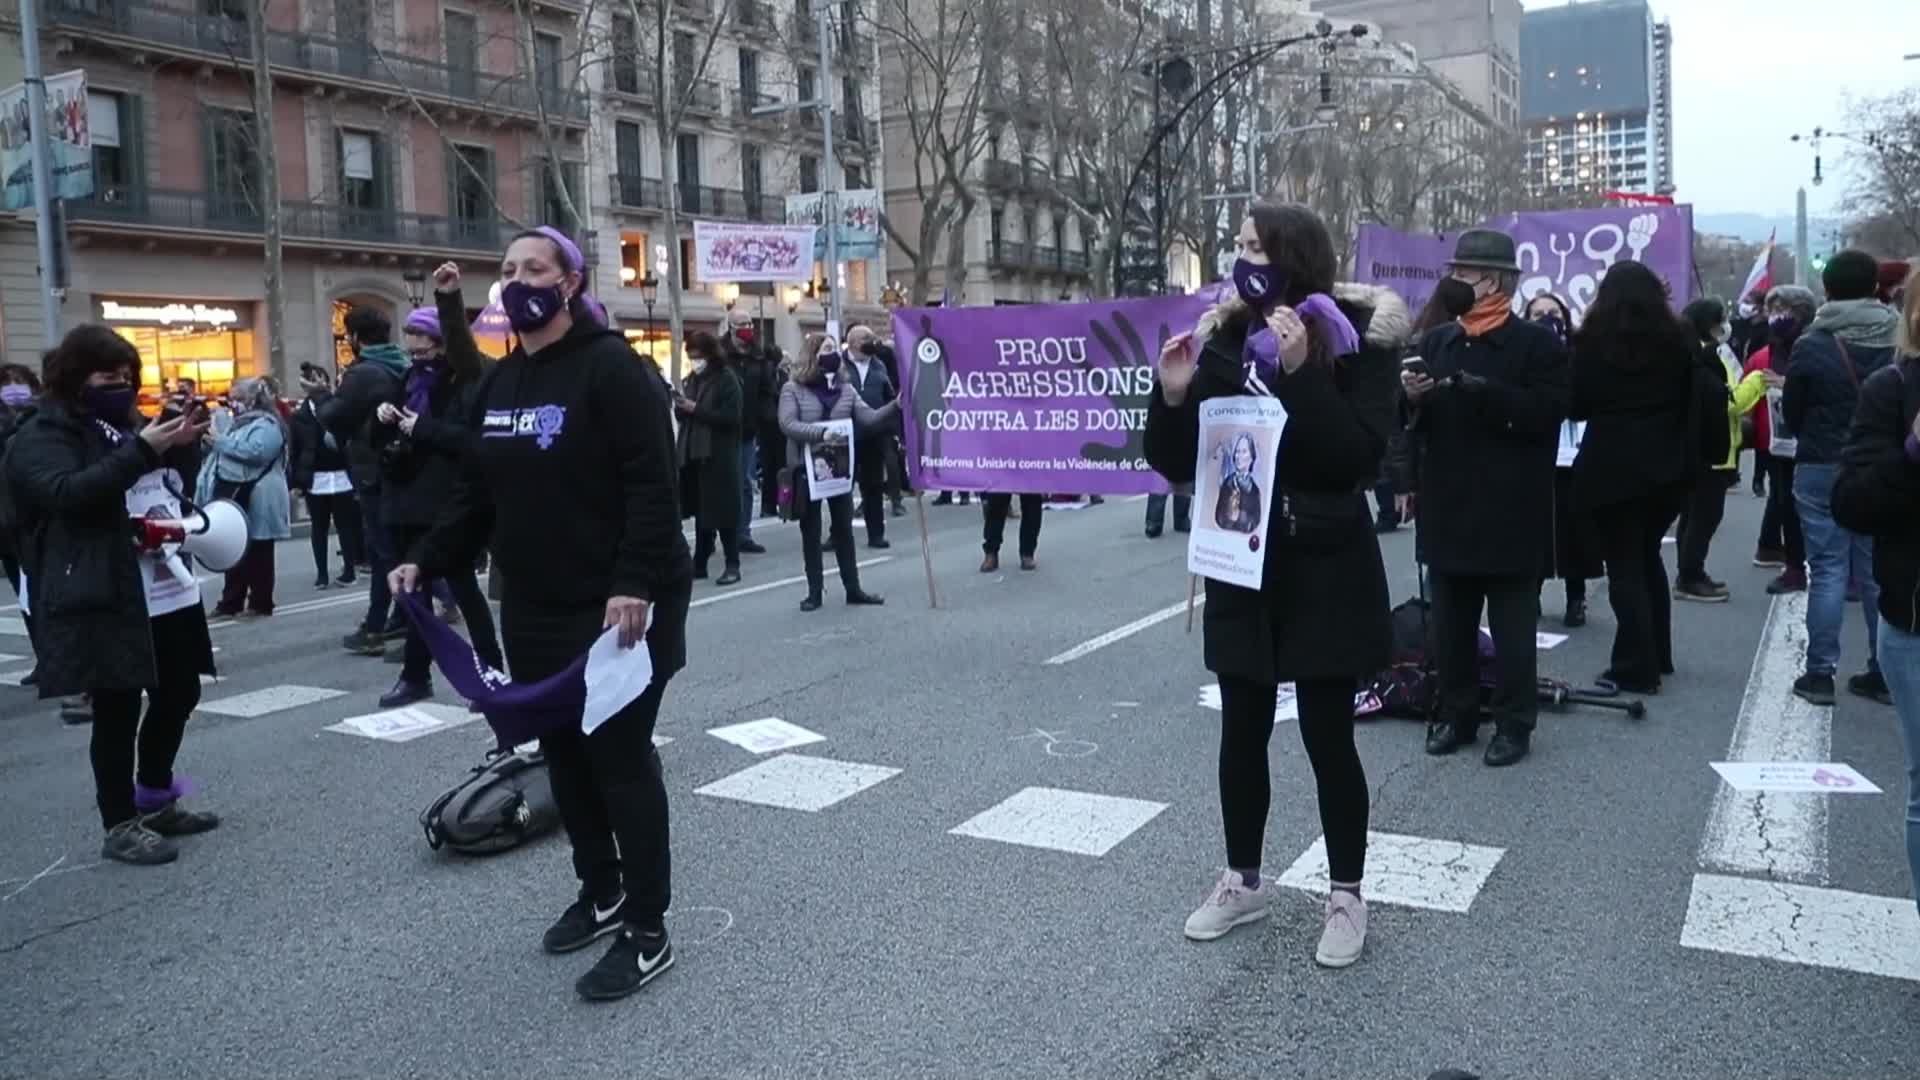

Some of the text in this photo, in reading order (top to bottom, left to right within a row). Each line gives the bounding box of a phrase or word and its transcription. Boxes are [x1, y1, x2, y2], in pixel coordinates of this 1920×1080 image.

[1372, 261, 1441, 280] Queremos
[995, 337, 1086, 366] PROU
[941, 366, 1153, 398] AGRESSIONS
[926, 408, 1028, 431] CONTRA
[1034, 408, 1079, 431] LES
[921, 456, 973, 469] Plataforma
[976, 456, 1016, 469] Unitària
[1018, 459, 1050, 470] contra
[1053, 458, 1066, 470] les
[1120, 457, 1132, 470] de
